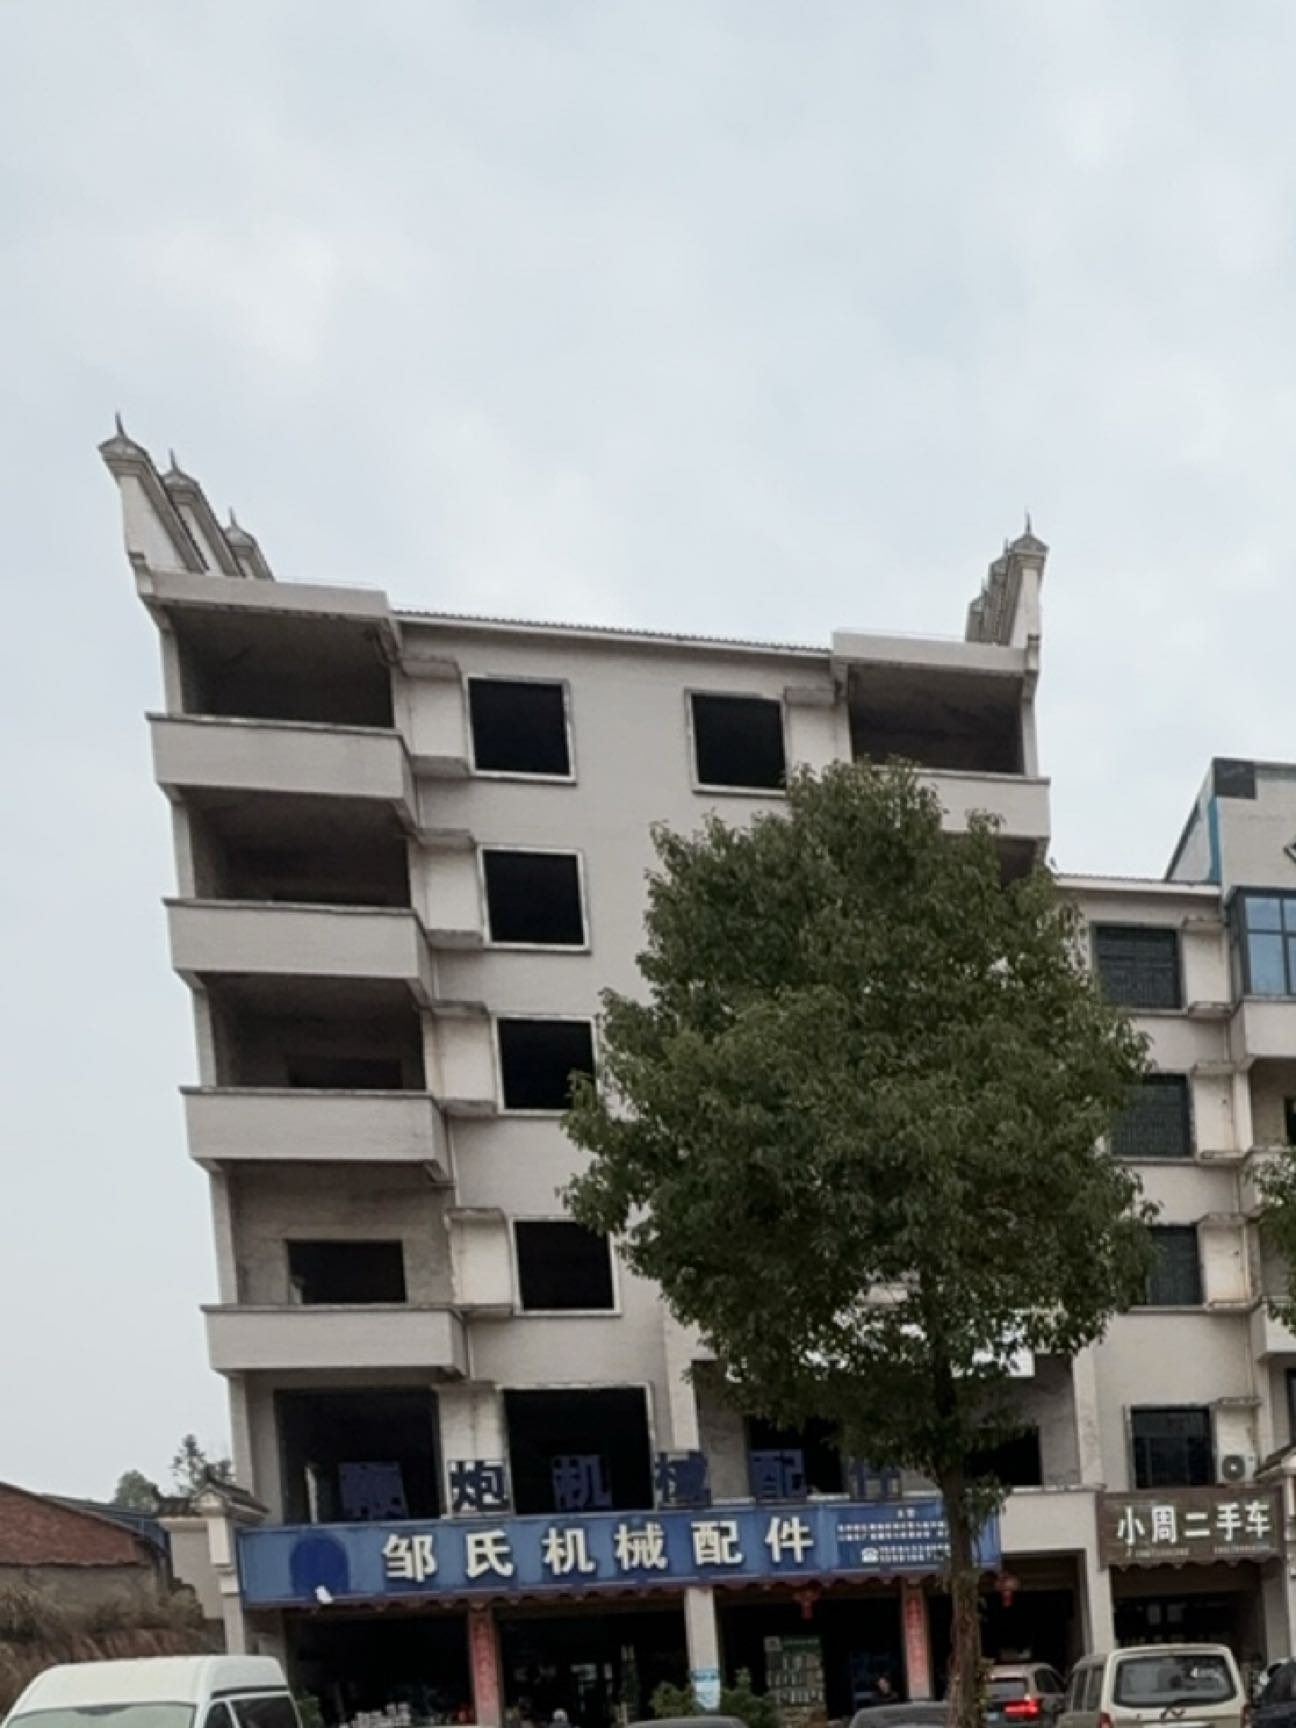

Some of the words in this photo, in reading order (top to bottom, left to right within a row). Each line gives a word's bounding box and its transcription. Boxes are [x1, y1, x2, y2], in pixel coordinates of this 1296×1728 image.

[382, 1516, 814, 1582] 邹氏机械配件
[1116, 1501, 1271, 1545] 小周二手车
